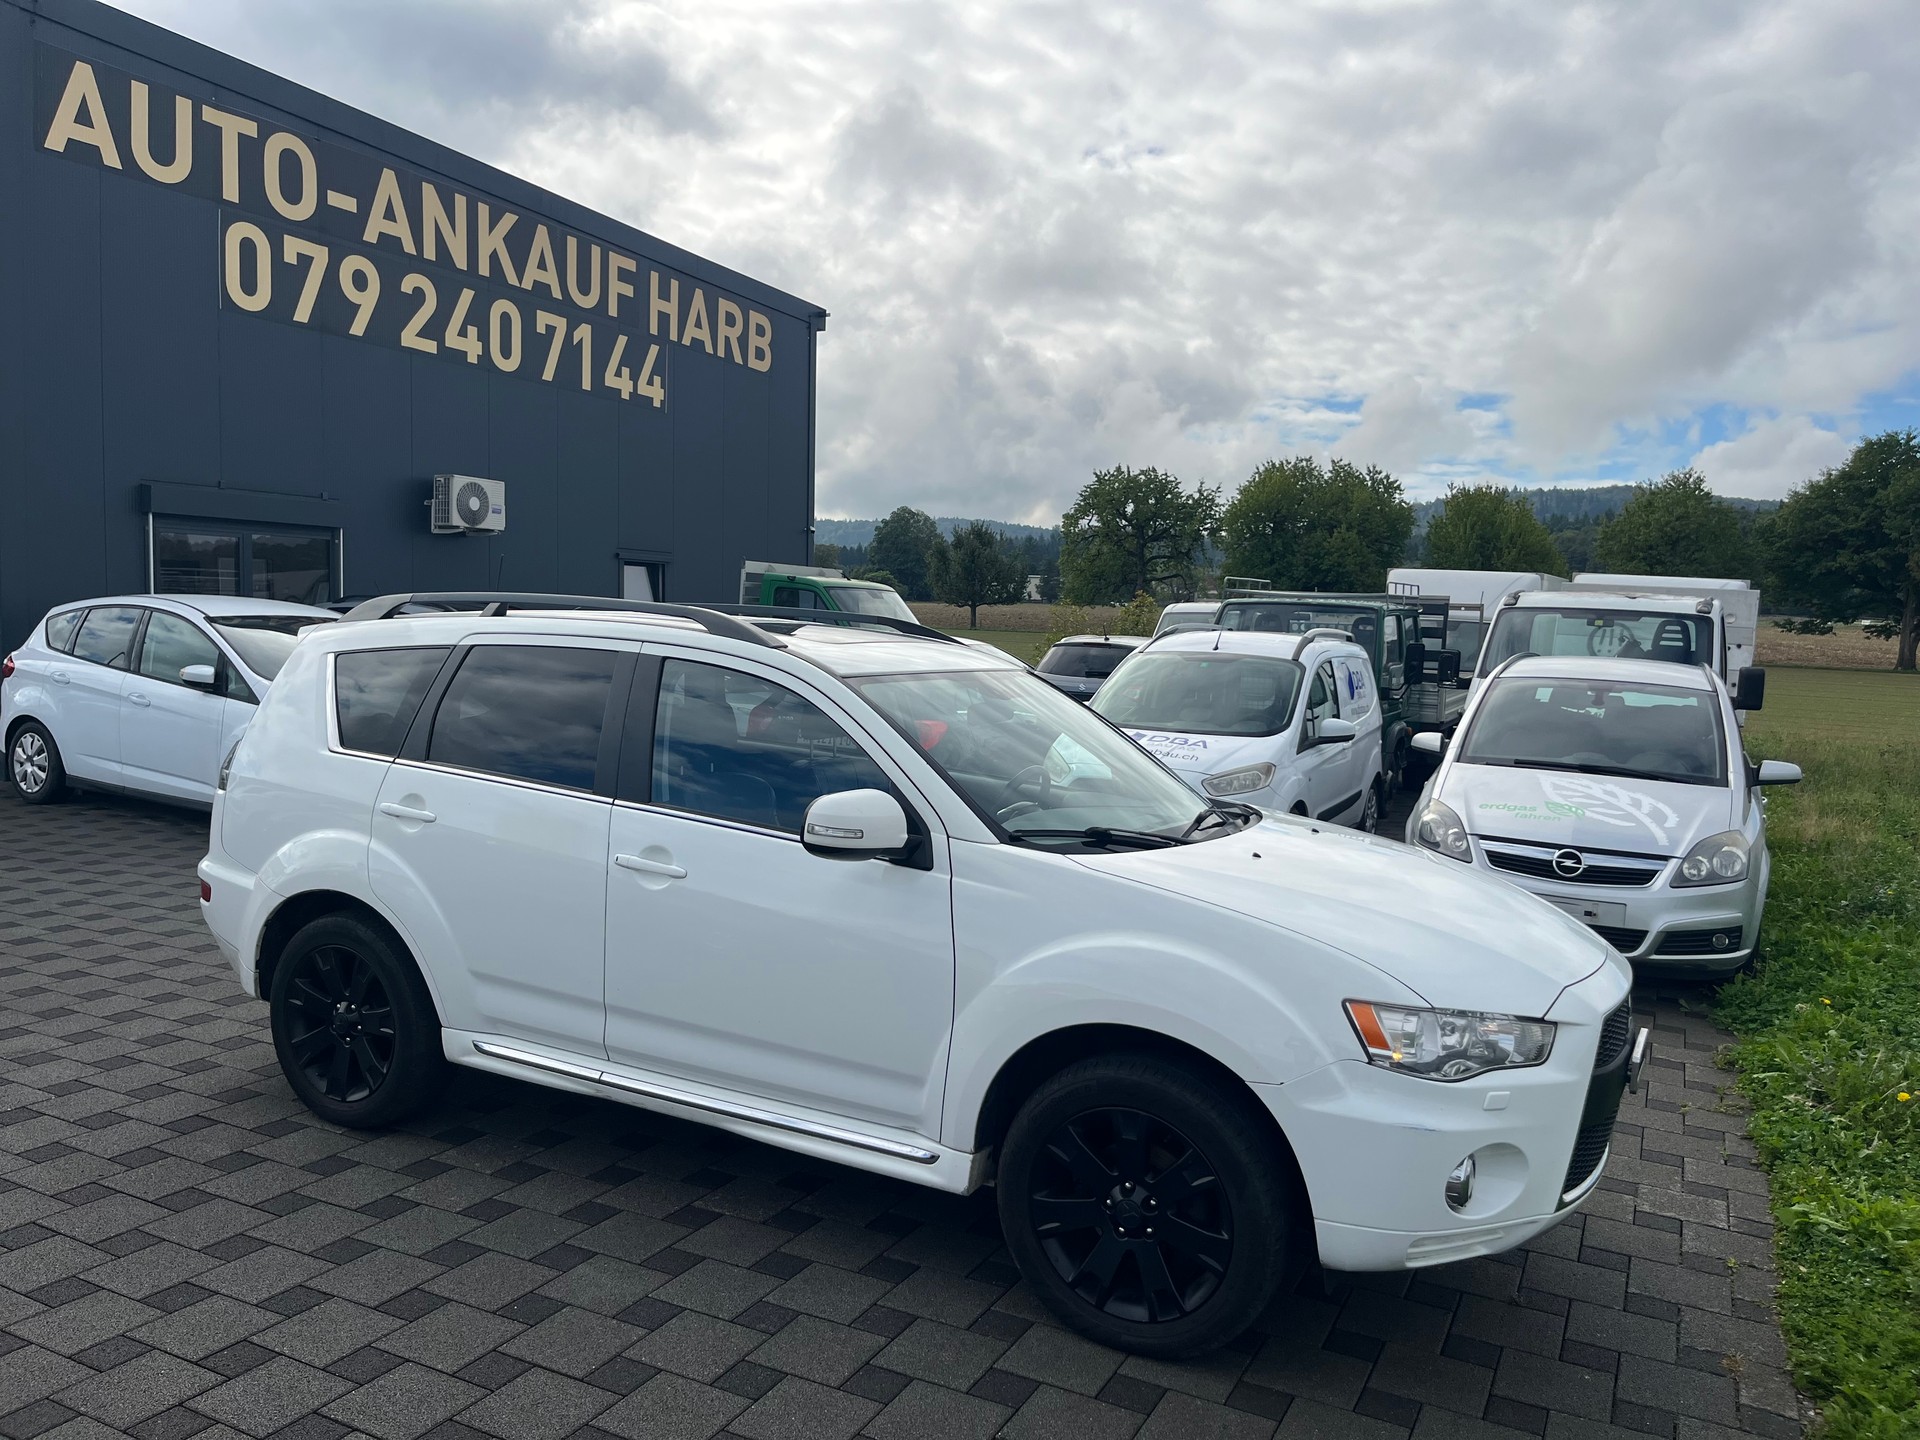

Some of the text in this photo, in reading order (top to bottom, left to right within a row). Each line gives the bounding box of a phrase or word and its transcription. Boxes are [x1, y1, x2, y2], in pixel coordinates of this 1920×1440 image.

[45, 62, 771, 372] AUTO-ANKAUF HARB
[225, 222, 664, 406] 079 240 7144
[1146, 735, 1208, 749] DBA
[1149, 748, 1199, 762] bau.ch
[1478, 802, 1538, 812] erdgas
[1513, 811, 1562, 822] fahren
